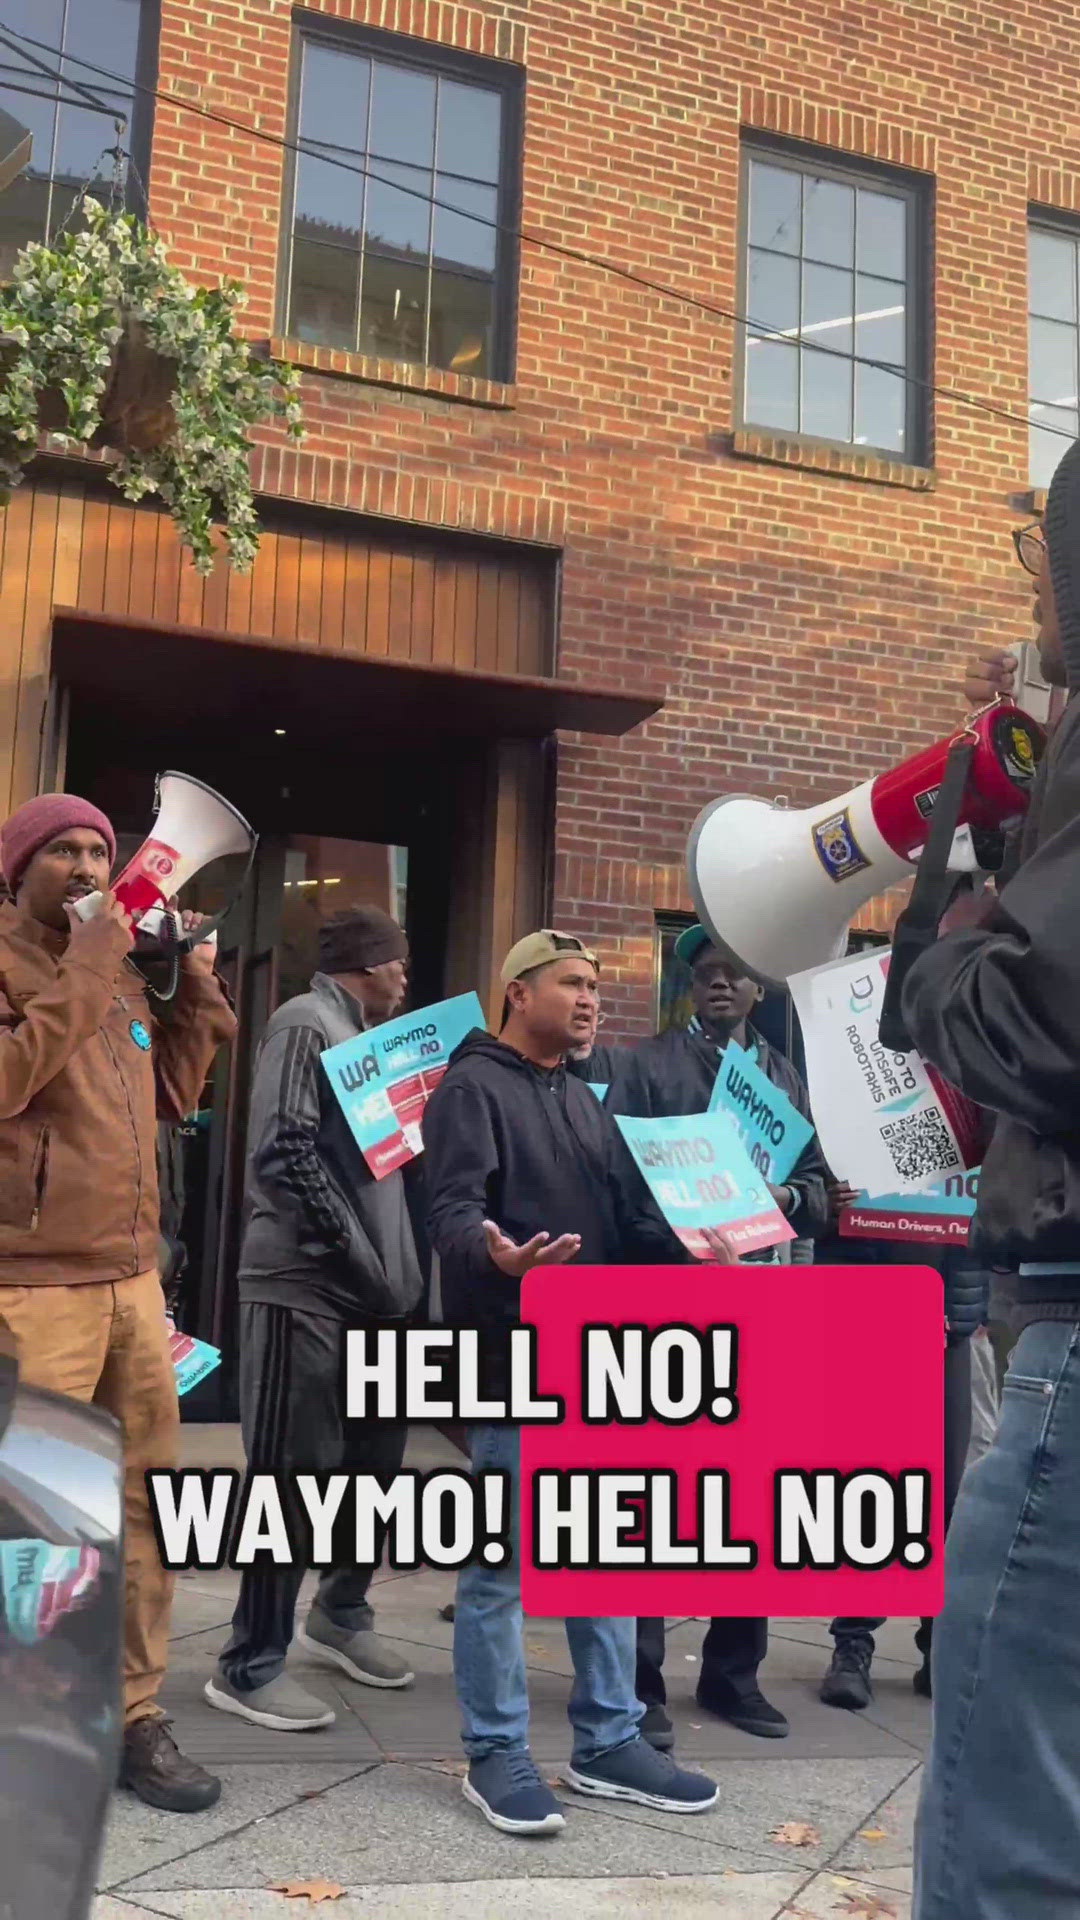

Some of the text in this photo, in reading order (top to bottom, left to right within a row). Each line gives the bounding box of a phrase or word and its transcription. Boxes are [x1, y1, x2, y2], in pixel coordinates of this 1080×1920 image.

[383, 1023, 438, 1053] WAYMO
[338, 1042, 381, 1092] WA
[846, 1024, 886, 1104] ROBOTAXIS
[901, 1066, 917, 1090] TO
[725, 1063, 786, 1147] WAYMO
[631, 1137, 716, 1168] WAYMO
[850, 1215, 895, 1230] Human
[898, 1218, 946, 1235] Drivers,
